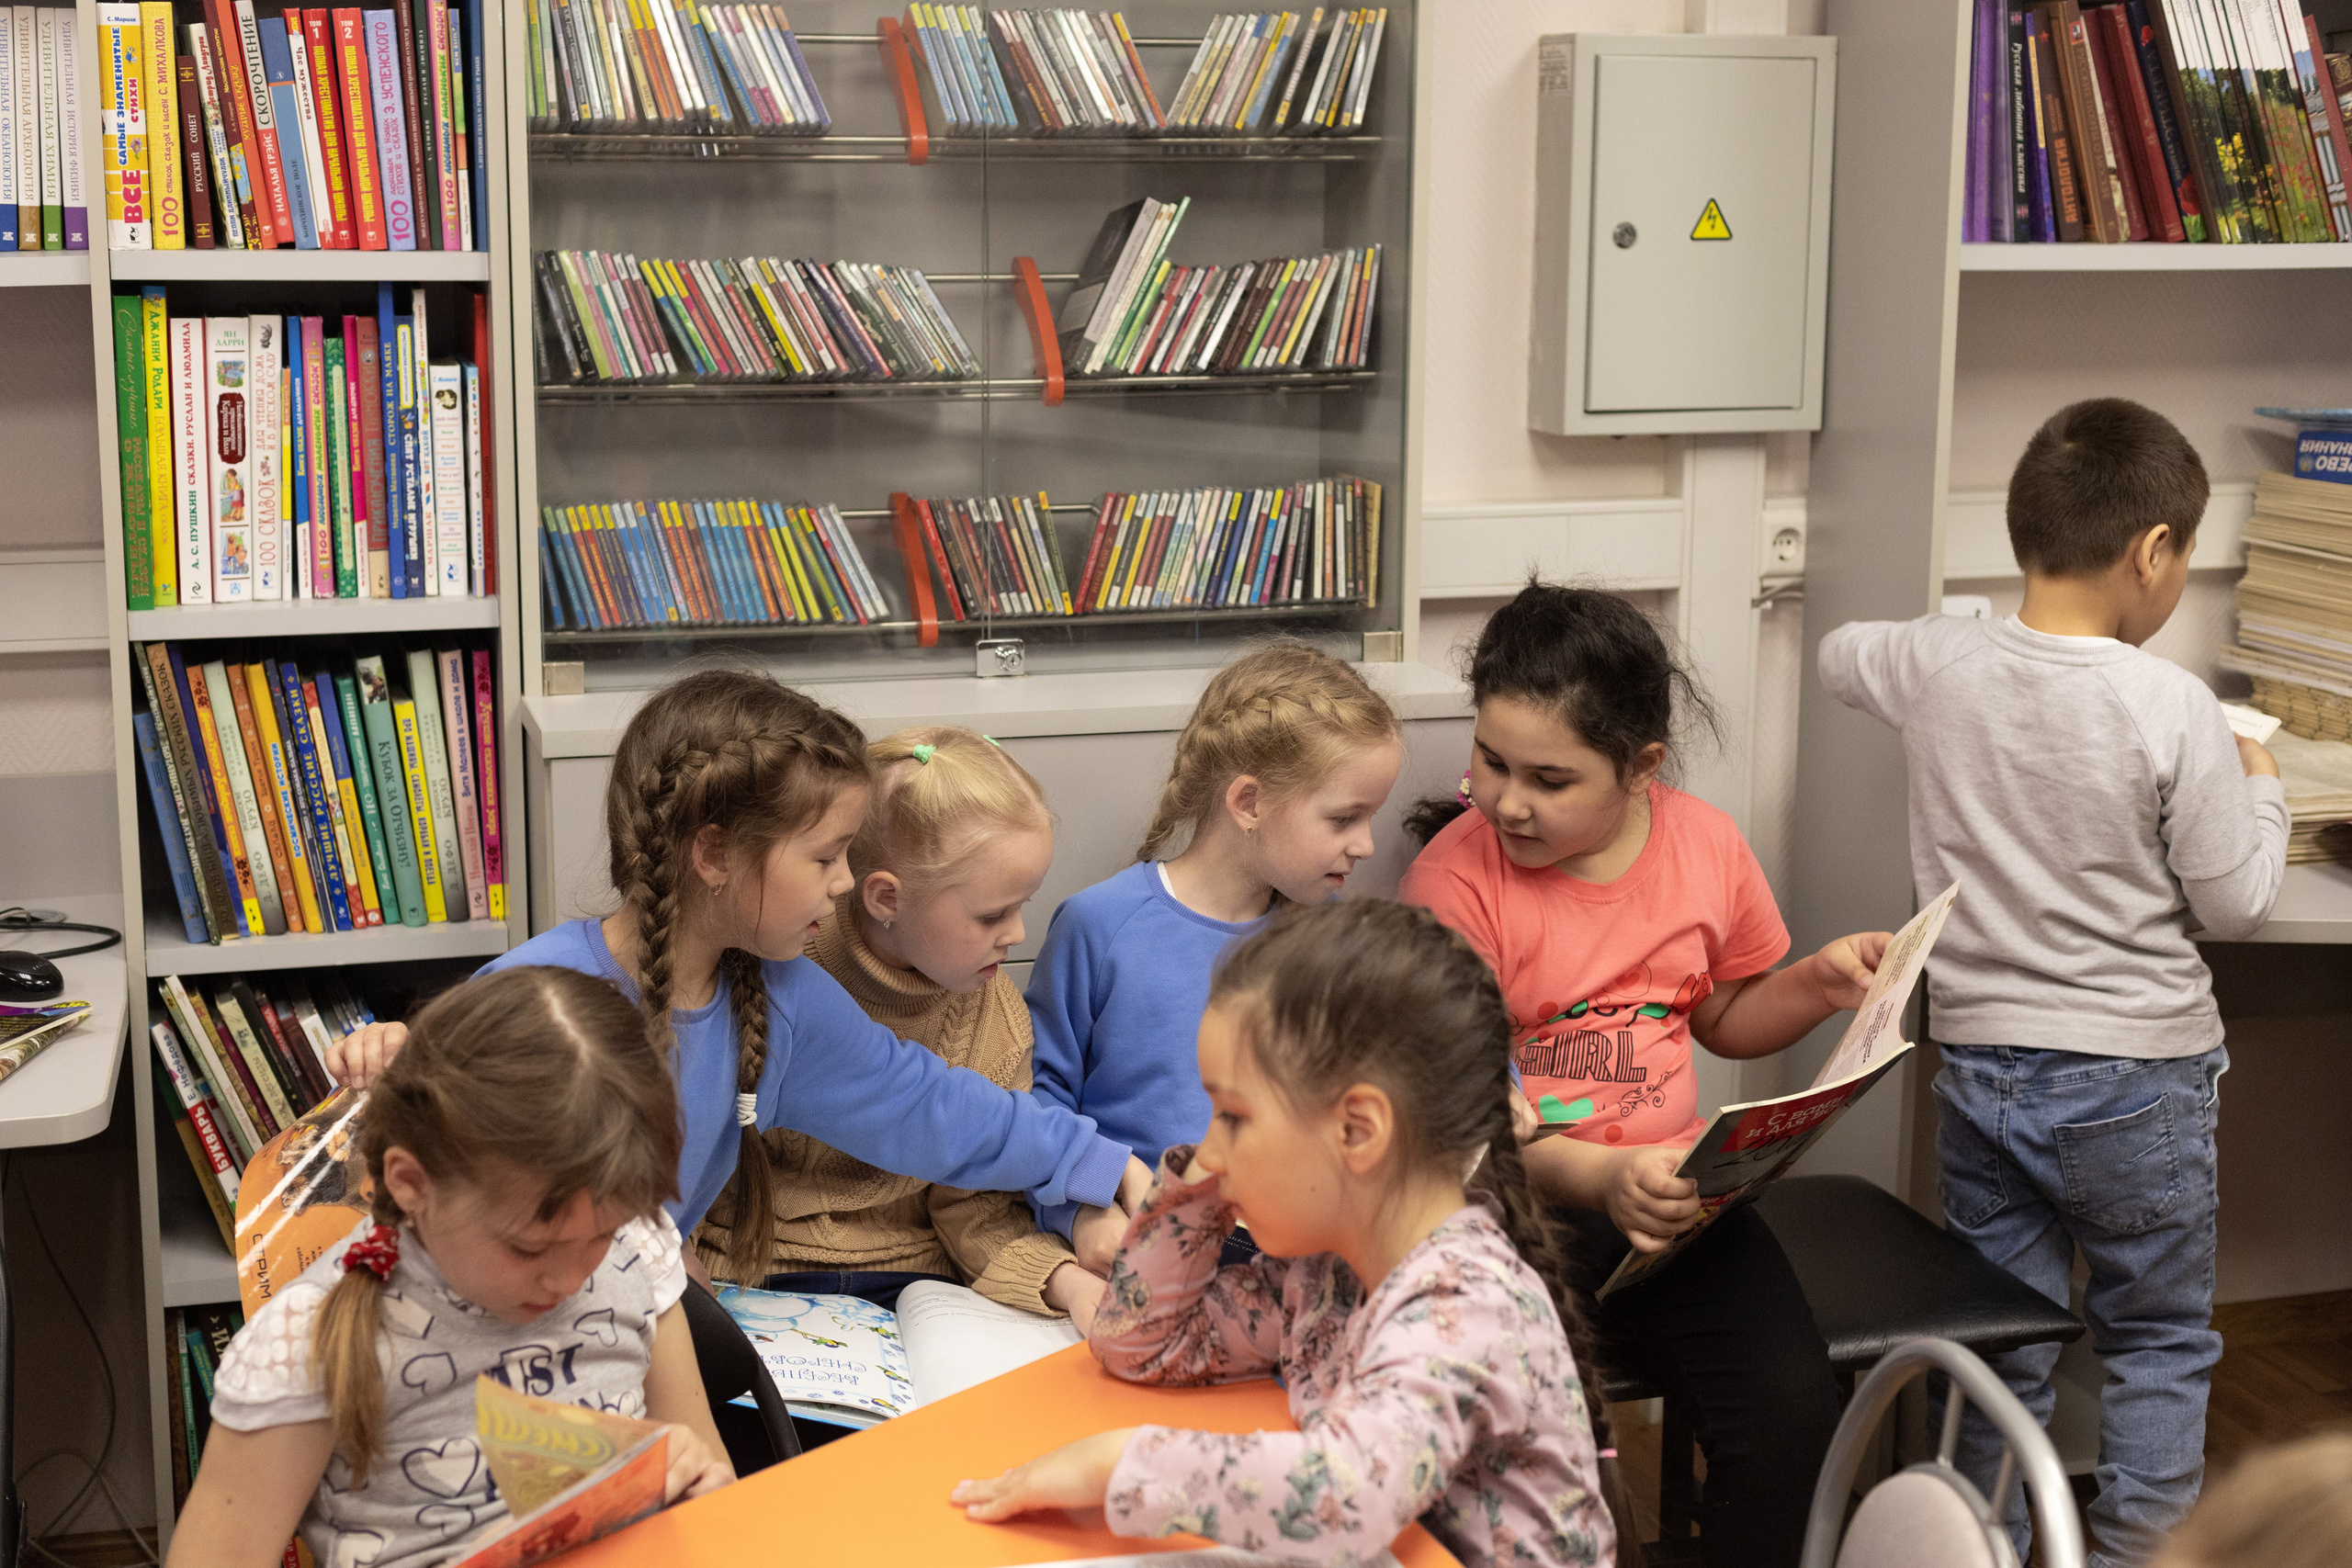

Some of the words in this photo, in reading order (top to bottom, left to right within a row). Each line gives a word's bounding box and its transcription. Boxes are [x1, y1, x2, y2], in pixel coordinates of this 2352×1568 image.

[154, 17, 168, 84] МИХАЛКОВА
[313, 28, 320, 39] 1
[345, 28, 353, 39] 2
[434, 8, 445, 51] СКАЗОК
[19, 17, 32, 116] УДИВИТЕЛЬНАЯ
[42, 20, 54, 139] УДИВИТЕЛЬНАЯ
[63, 20, 74, 105] УДИВИТЕЛЬНАЯ
[111, 26, 125, 118] ЗНАМЕНИТЫЕ
[241, 15, 270, 126] СКОРОЧТЕНИЕ
[313, 45, 325, 74] ПОЛНАЯ
[345, 45, 357, 74] ПОЛНАЯ
[375, 21, 393, 101] УСПЕНСКОГО
[2011, 42, 2023, 87] Русская
[128, 78, 139, 123] СТИХИ
[160, 86, 168, 96] С.
[296, 46, 304, 65] Час
[300, 69, 311, 120] мужества
[318, 76, 335, 130] ХРЕСТОМАТИЯ
[349, 75, 365, 130] ХРЕСТОМАТИЯ
[439, 54, 449, 118] МАЛЕНЬКИХ
[188, 113, 198, 143] СОНЕТ
[384, 102, 395, 114] Э.
[67, 109, 77, 157] ИСТОРИЯ
[117, 121, 127, 166] САМЫЕ
[164, 130, 175, 160] сказок
[263, 132, 276, 166] ГРЭЙС
[323, 130, 337, 147] ДЛЯ
[353, 131, 367, 147] ДЛЯ
[390, 118, 401, 152] СКАЗОК
[441, 121, 451, 174] ЛЮБИМЫХ
[1, 117, 12, 200] ОКЕАНОЛОГИЯ
[23, 119, 34, 201] АРХЕОЛОГИЯ
[46, 145, 56, 198] ХИМИЯ
[191, 152, 204, 193] РУССКИЙ
[327, 148, 345, 191] НАЧАЛЬНОЙ
[356, 148, 372, 191] НАЧАЛЬНОЙ
[70, 160, 80, 201] ФИЗИКИ
[121, 169, 143, 224] ВСЕ
[269, 168, 286, 212] НАТАЛЬЯ
[2054, 137, 2078, 224] АНТОЛОГИЯ
[162, 196, 179, 238] 100
[334, 192, 347, 222] ШКОЛЫ
[361, 192, 376, 222] ШКОЛЫ
[391, 199, 411, 242] 100
[182, 321, 192, 379] ЛЮДМИЛА
[223, 330, 237, 338] ЯН
[255, 354, 265, 386] ДОМА
[266, 352, 276, 379] САДУ
[384, 341, 393, 378] МАЯКЕ
[255, 388, 266, 425] ЧТЕНИЯ
[310, 365, 321, 405] СКАЗОК
[386, 382, 394, 397] НА
[184, 392, 195, 436] РУСЛАН
[266, 387, 276, 430] ДЕТСКОМ
[386, 400, 395, 446] СТОРОЖ
[124, 437, 132, 453] О
[154, 415, 166, 471] БОЛЬШАЯ
[256, 429, 266, 450] ДЛЯ
[312, 409, 323, 472] МАЛЕНЬКИХ
[403, 433, 413, 460] СПЯТ
[132, 435, 145, 516] РАССКАЗЫ
[186, 439, 196, 486] СКАЗКИ.
[157, 473, 169, 513] КНИГА
[258, 478, 276, 536] СКАЗОК
[316, 473, 325, 525] ЛЮБИМЫХ
[405, 462, 416, 511] УСТАЛЫЕ
[125, 461, 140, 598] ЖИВОТНЫХ
[137, 520, 145, 531] И
[187, 490, 198, 542] ПУШКИН
[407, 514, 418, 560] ИГРУШКИ
[189, 545, 198, 556] С.
[259, 540, 276, 567] 100
[425, 511, 434, 566] МАРШАК
[138, 536, 150, 597] СКАЗКИ
[190, 558, 199, 570] А.
[156, 662, 175, 709] СКАЗОК
[450, 659, 460, 684] дома
[289, 688, 309, 744] СКАЗКИ
[401, 717, 413, 733] ПРО
[454, 694, 464, 726] школе
[170, 712, 191, 766] РУССКИХ
[404, 734, 419, 772] МАШИНЫ,
[458, 736, 470, 773] Малеев
[270, 742, 288, 787] ИСТОРИИ
[378, 739, 395, 784] КУБОК
[303, 751, 325, 816] РУССКИЕ
[387, 787, 398, 802] ЗА
[438, 777, 452, 818] КРУЗО
[461, 774, 470, 797] Витя
[243, 788, 260, 829] КРУЗО
[280, 789, 302, 858] КОСМИЧЕСКИЕ
[318, 821, 339, 882] ЛУЧШИЕ
[390, 805, 412, 869] ОТЧИЗНУ!
[417, 816, 431, 852] КОРАБЛИ
[253, 851, 269, 887] ДЕФО
[424, 857, 436, 886] ПОЕЗДА
[163, 1033, 190, 1089] Нефёдова
[1516, 1030, 1647, 1083] GIRL
[187, 1090, 196, 1101] Е.
[195, 1105, 231, 1172] БУКВАРЬ
[253, 1234, 272, 1299] СТРИМ
